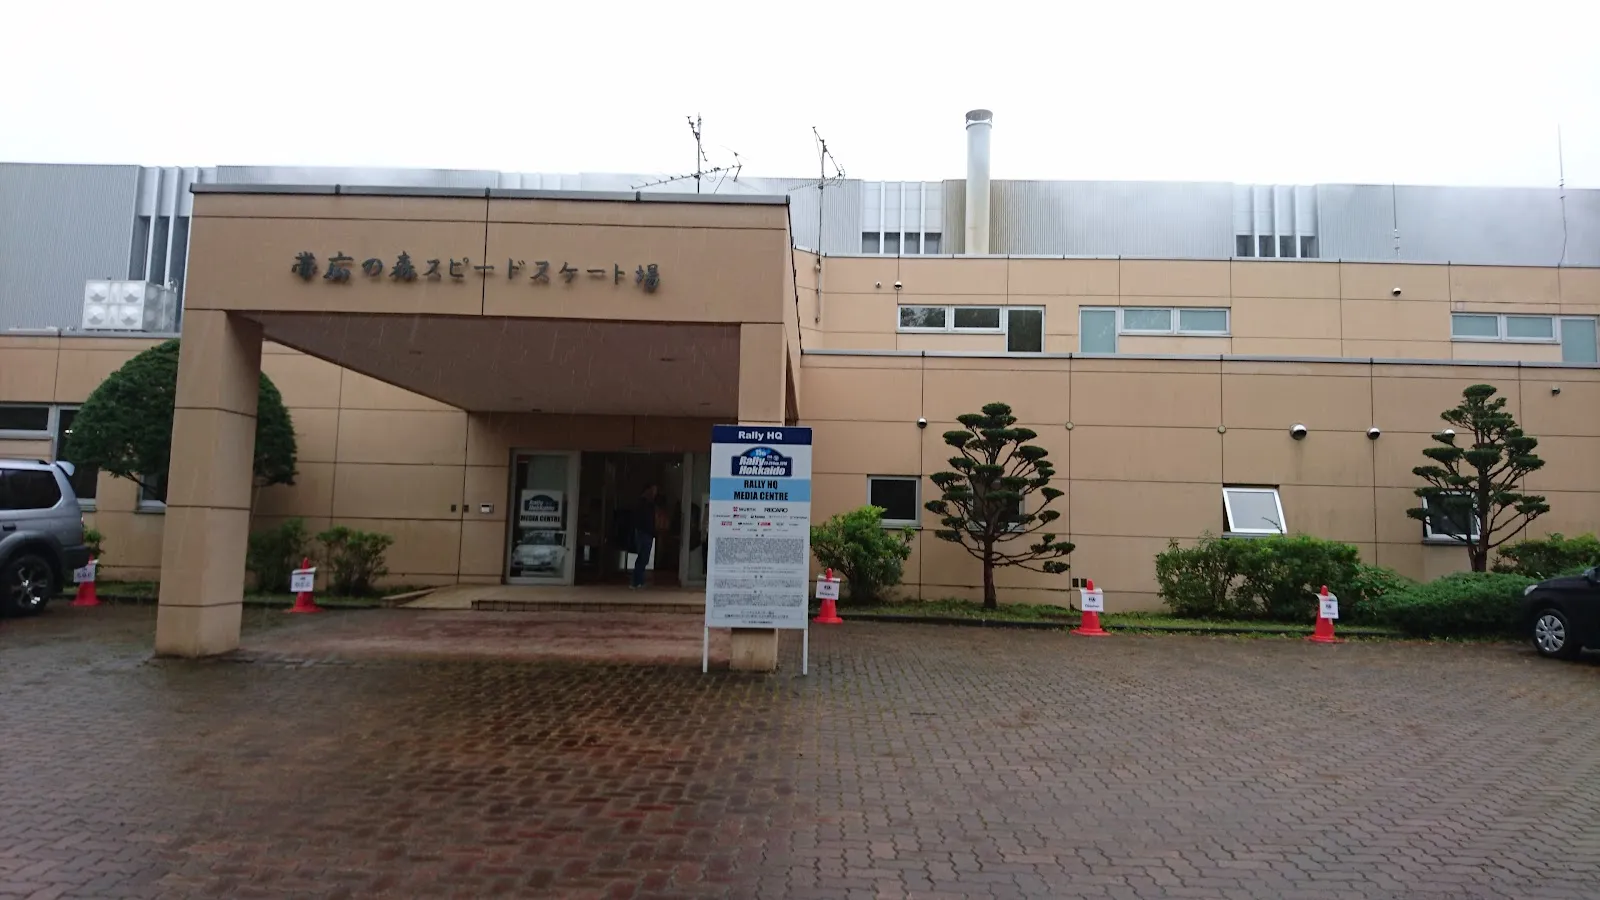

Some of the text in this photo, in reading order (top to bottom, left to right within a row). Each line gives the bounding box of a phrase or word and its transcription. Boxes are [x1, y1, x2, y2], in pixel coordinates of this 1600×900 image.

[291, 251, 661, 293] 帯広の森スピードスケート場
[738, 431, 783, 441] Rally HQ
[739, 456, 765, 466] Rally
[739, 466, 786, 475] Hokkaido
[744, 480, 778, 490] RALLY HQ
[734, 491, 788, 501] MEDIA CENTRE
